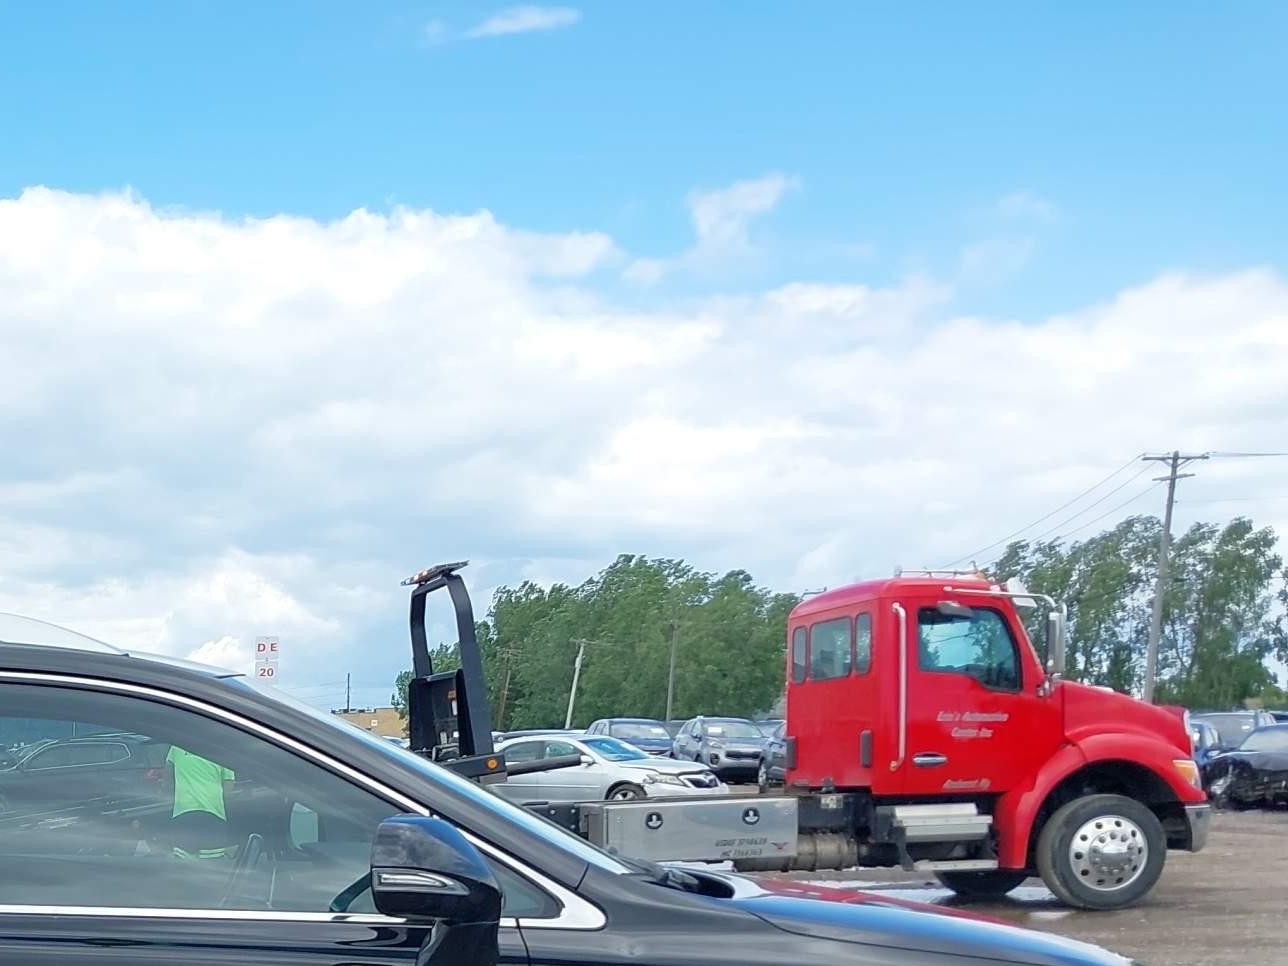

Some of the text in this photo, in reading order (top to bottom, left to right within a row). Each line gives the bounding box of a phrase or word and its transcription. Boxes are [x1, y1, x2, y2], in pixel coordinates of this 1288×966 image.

[257, 643, 277, 652] D E
[259, 668, 274, 677] 20
